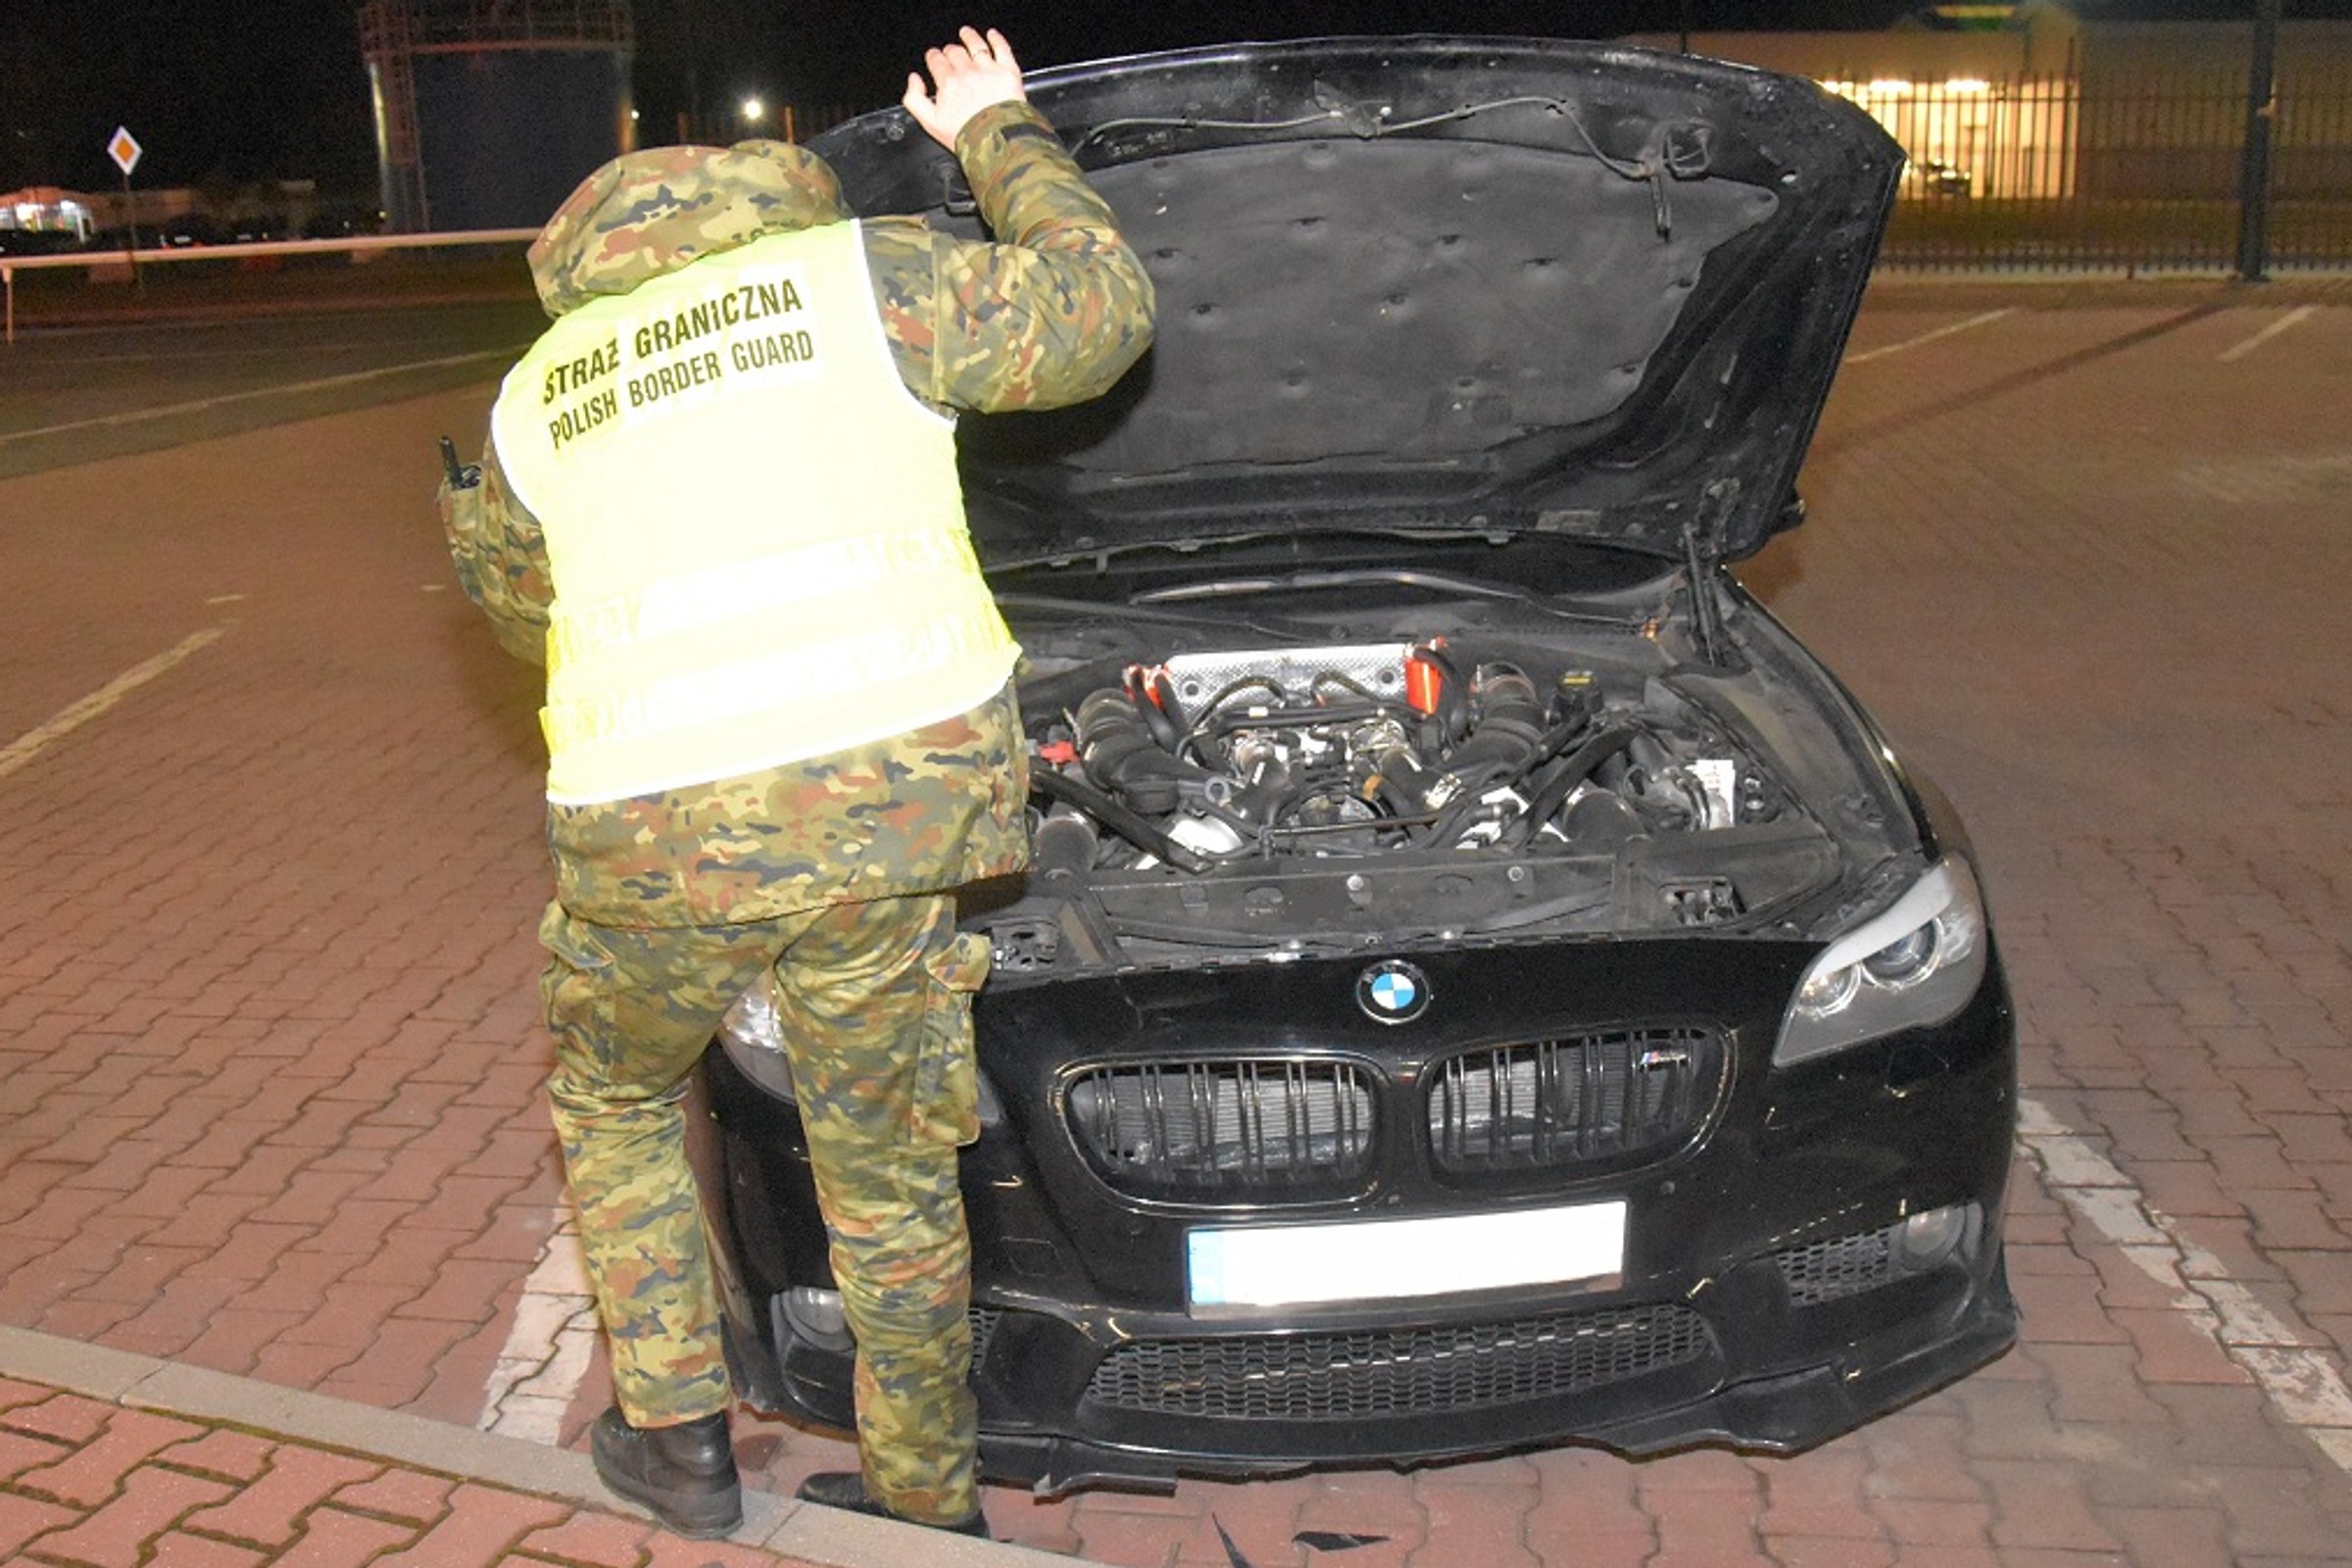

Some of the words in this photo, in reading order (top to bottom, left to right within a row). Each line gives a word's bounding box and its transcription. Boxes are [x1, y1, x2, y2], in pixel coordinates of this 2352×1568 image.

[634, 278, 803, 360] GRANICZNA
[549, 388, 618, 450] POLISH
[628, 351, 722, 408] BORDER
[731, 330, 815, 372] GUARD
